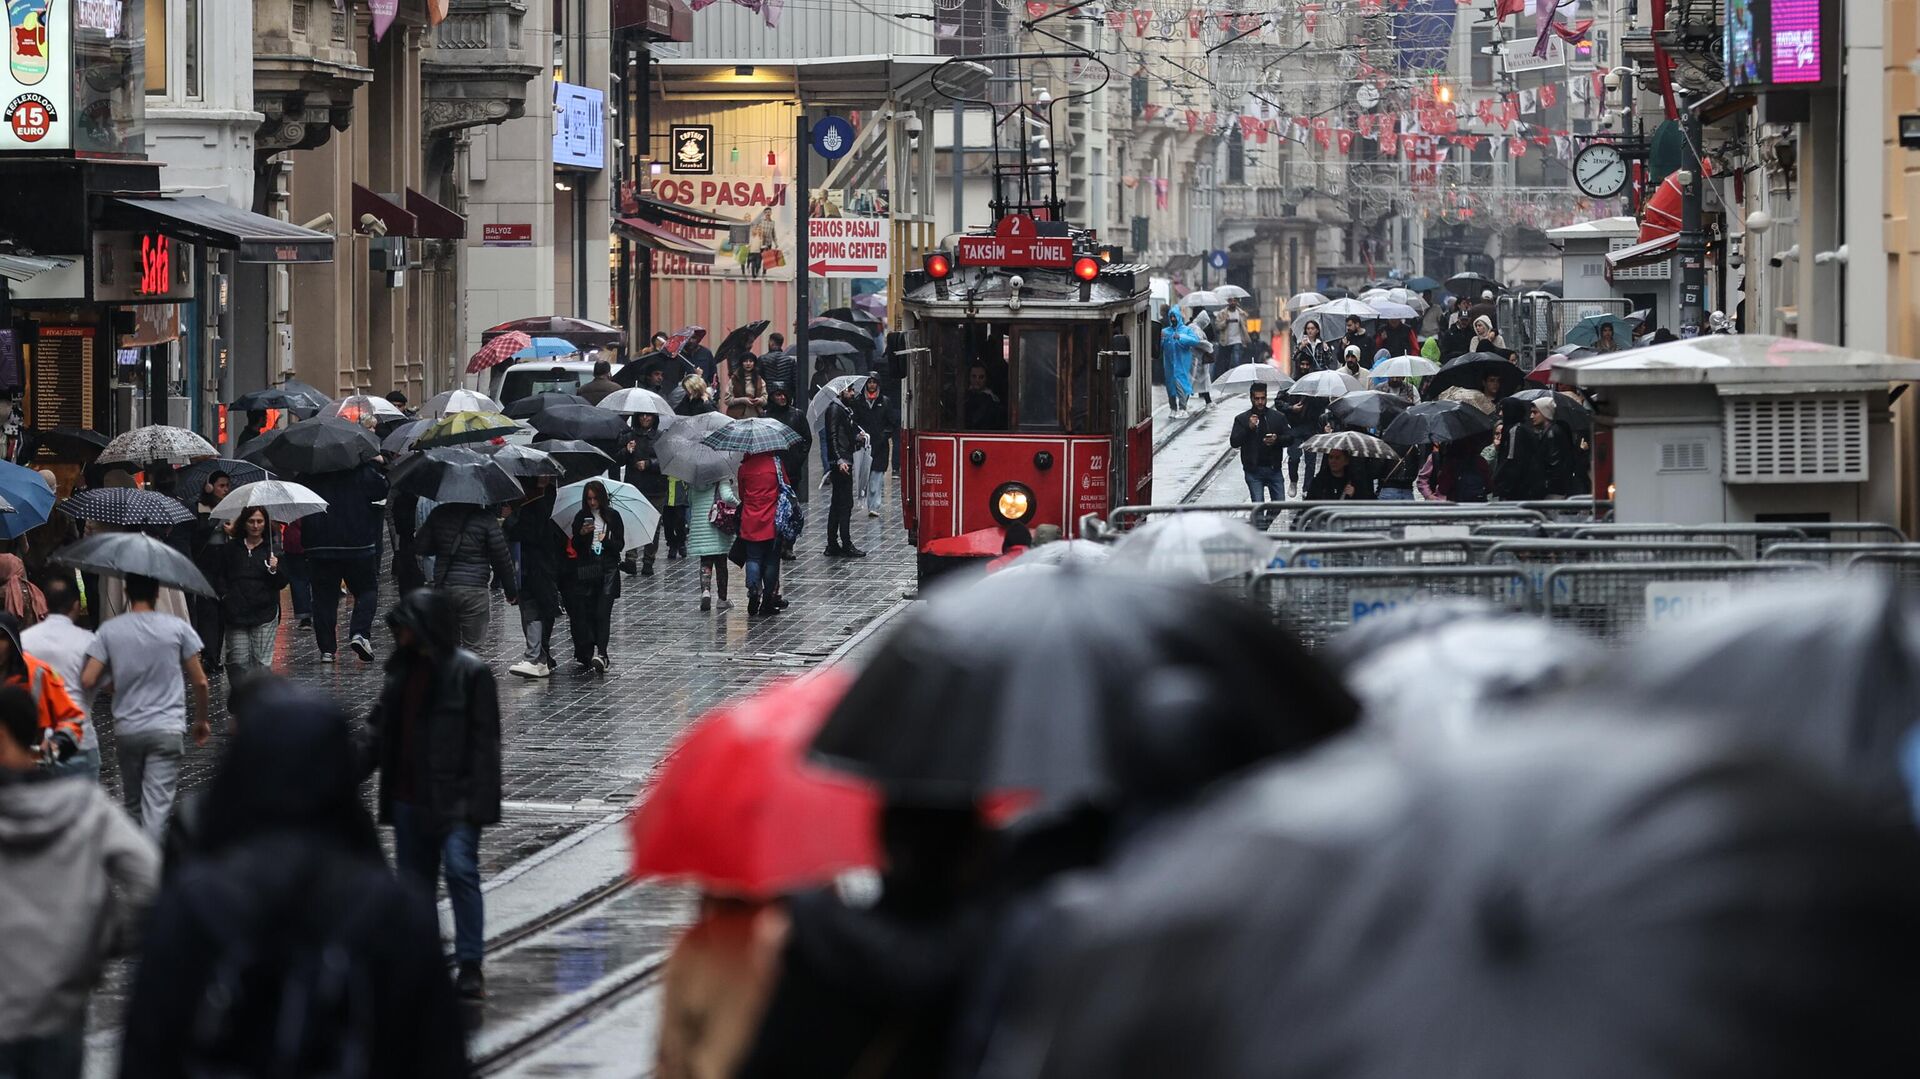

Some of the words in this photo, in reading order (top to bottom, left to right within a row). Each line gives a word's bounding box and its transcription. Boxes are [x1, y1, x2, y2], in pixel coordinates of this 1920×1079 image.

[6, 94, 55, 116] REFLEXOLOGY
[15, 107, 43, 126] 15
[846, 221, 880, 237] PASAJI
[1011, 217, 1020, 235] 2
[809, 242, 846, 258] OPPING
[848, 242, 887, 259] CENTER
[963, 241, 1005, 260] TAKSİM
[1029, 242, 1066, 261] TÜNEL
[925, 452, 936, 467] 223
[1090, 455, 1103, 469] 223
